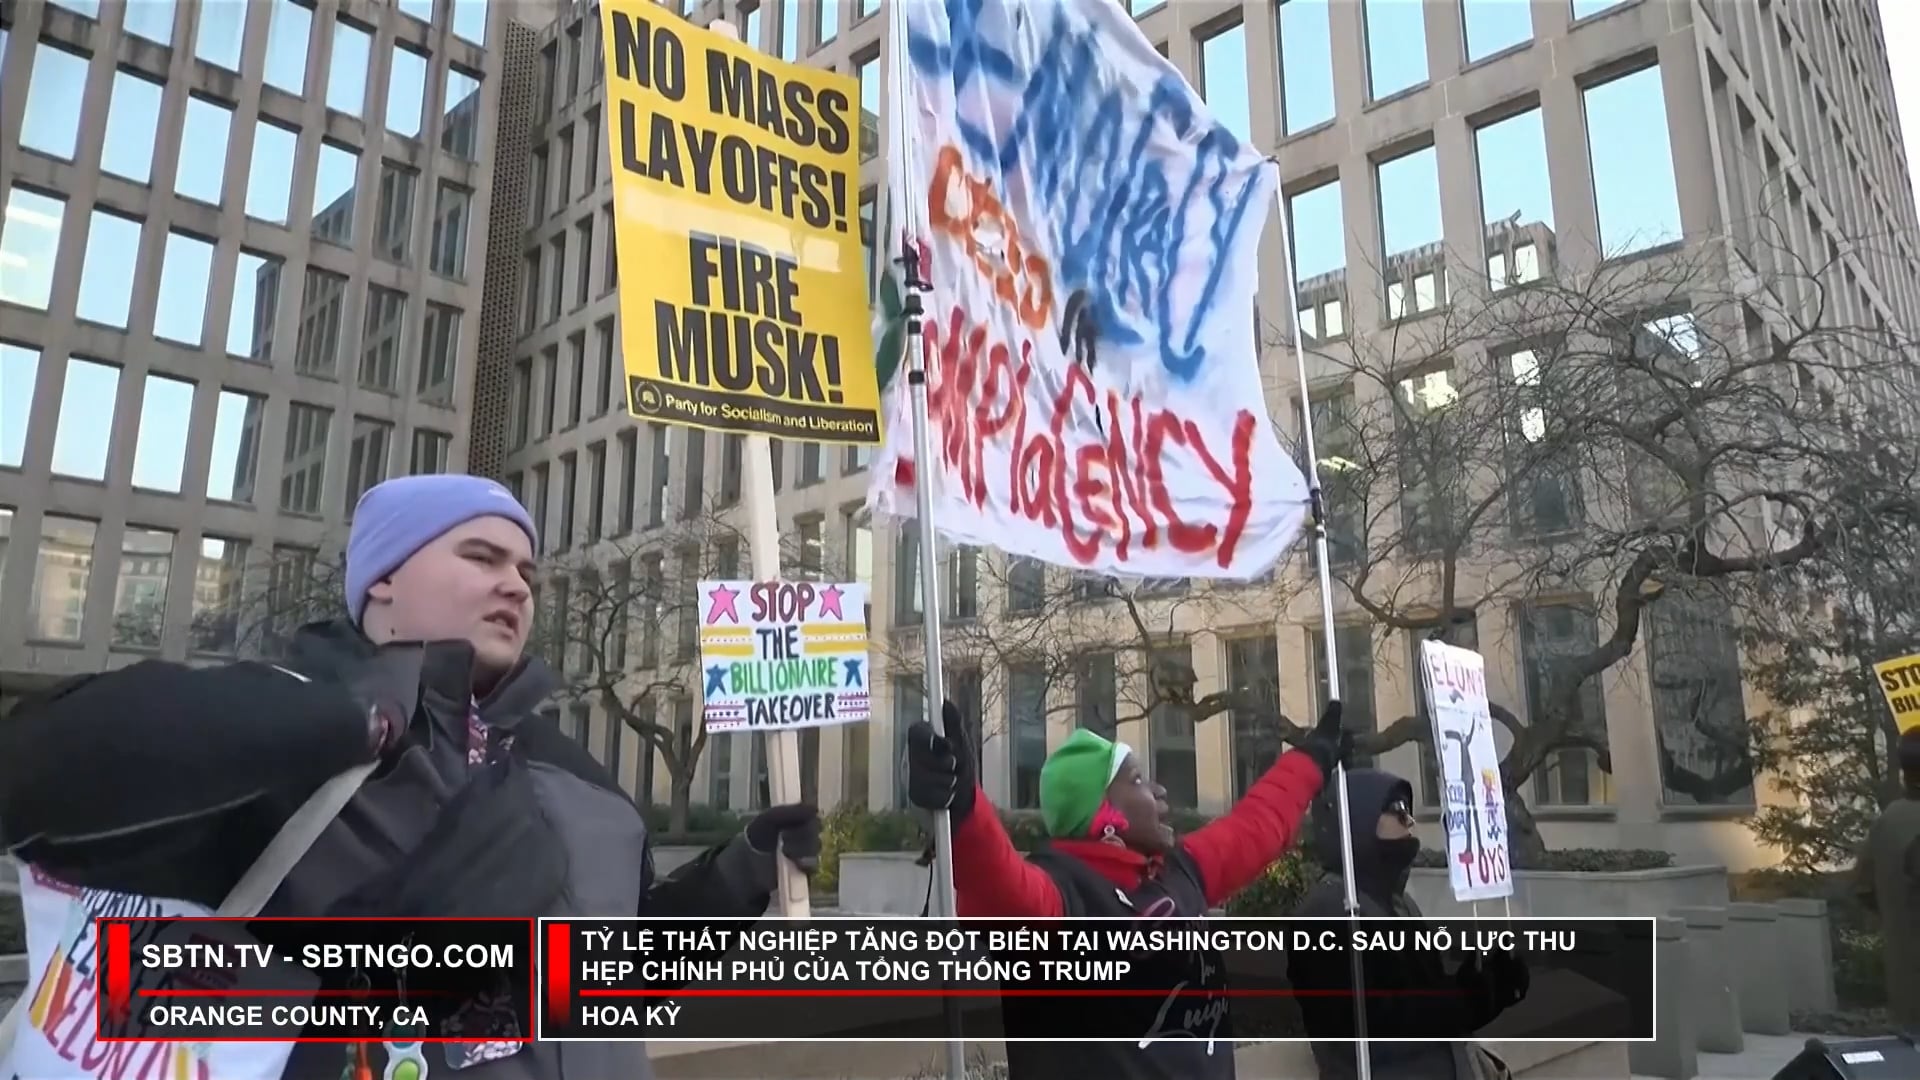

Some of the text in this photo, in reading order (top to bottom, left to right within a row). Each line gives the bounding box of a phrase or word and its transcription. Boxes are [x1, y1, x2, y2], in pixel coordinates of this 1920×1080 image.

[611, 9, 850, 156] NO MASS
[619, 100, 848, 234] LAYOFFS!
[688, 229, 803, 327] FIRE
[653, 299, 844, 404] MUSK!
[665, 393, 874, 433] Party for Socialism and Liberation
[750, 581, 815, 623] STOP
[755, 625, 800, 661] THE
[730, 656, 839, 694] BILLIONAIRE
[744, 692, 836, 726] TAKEOVER
[1457, 842, 1507, 888] TOYS
